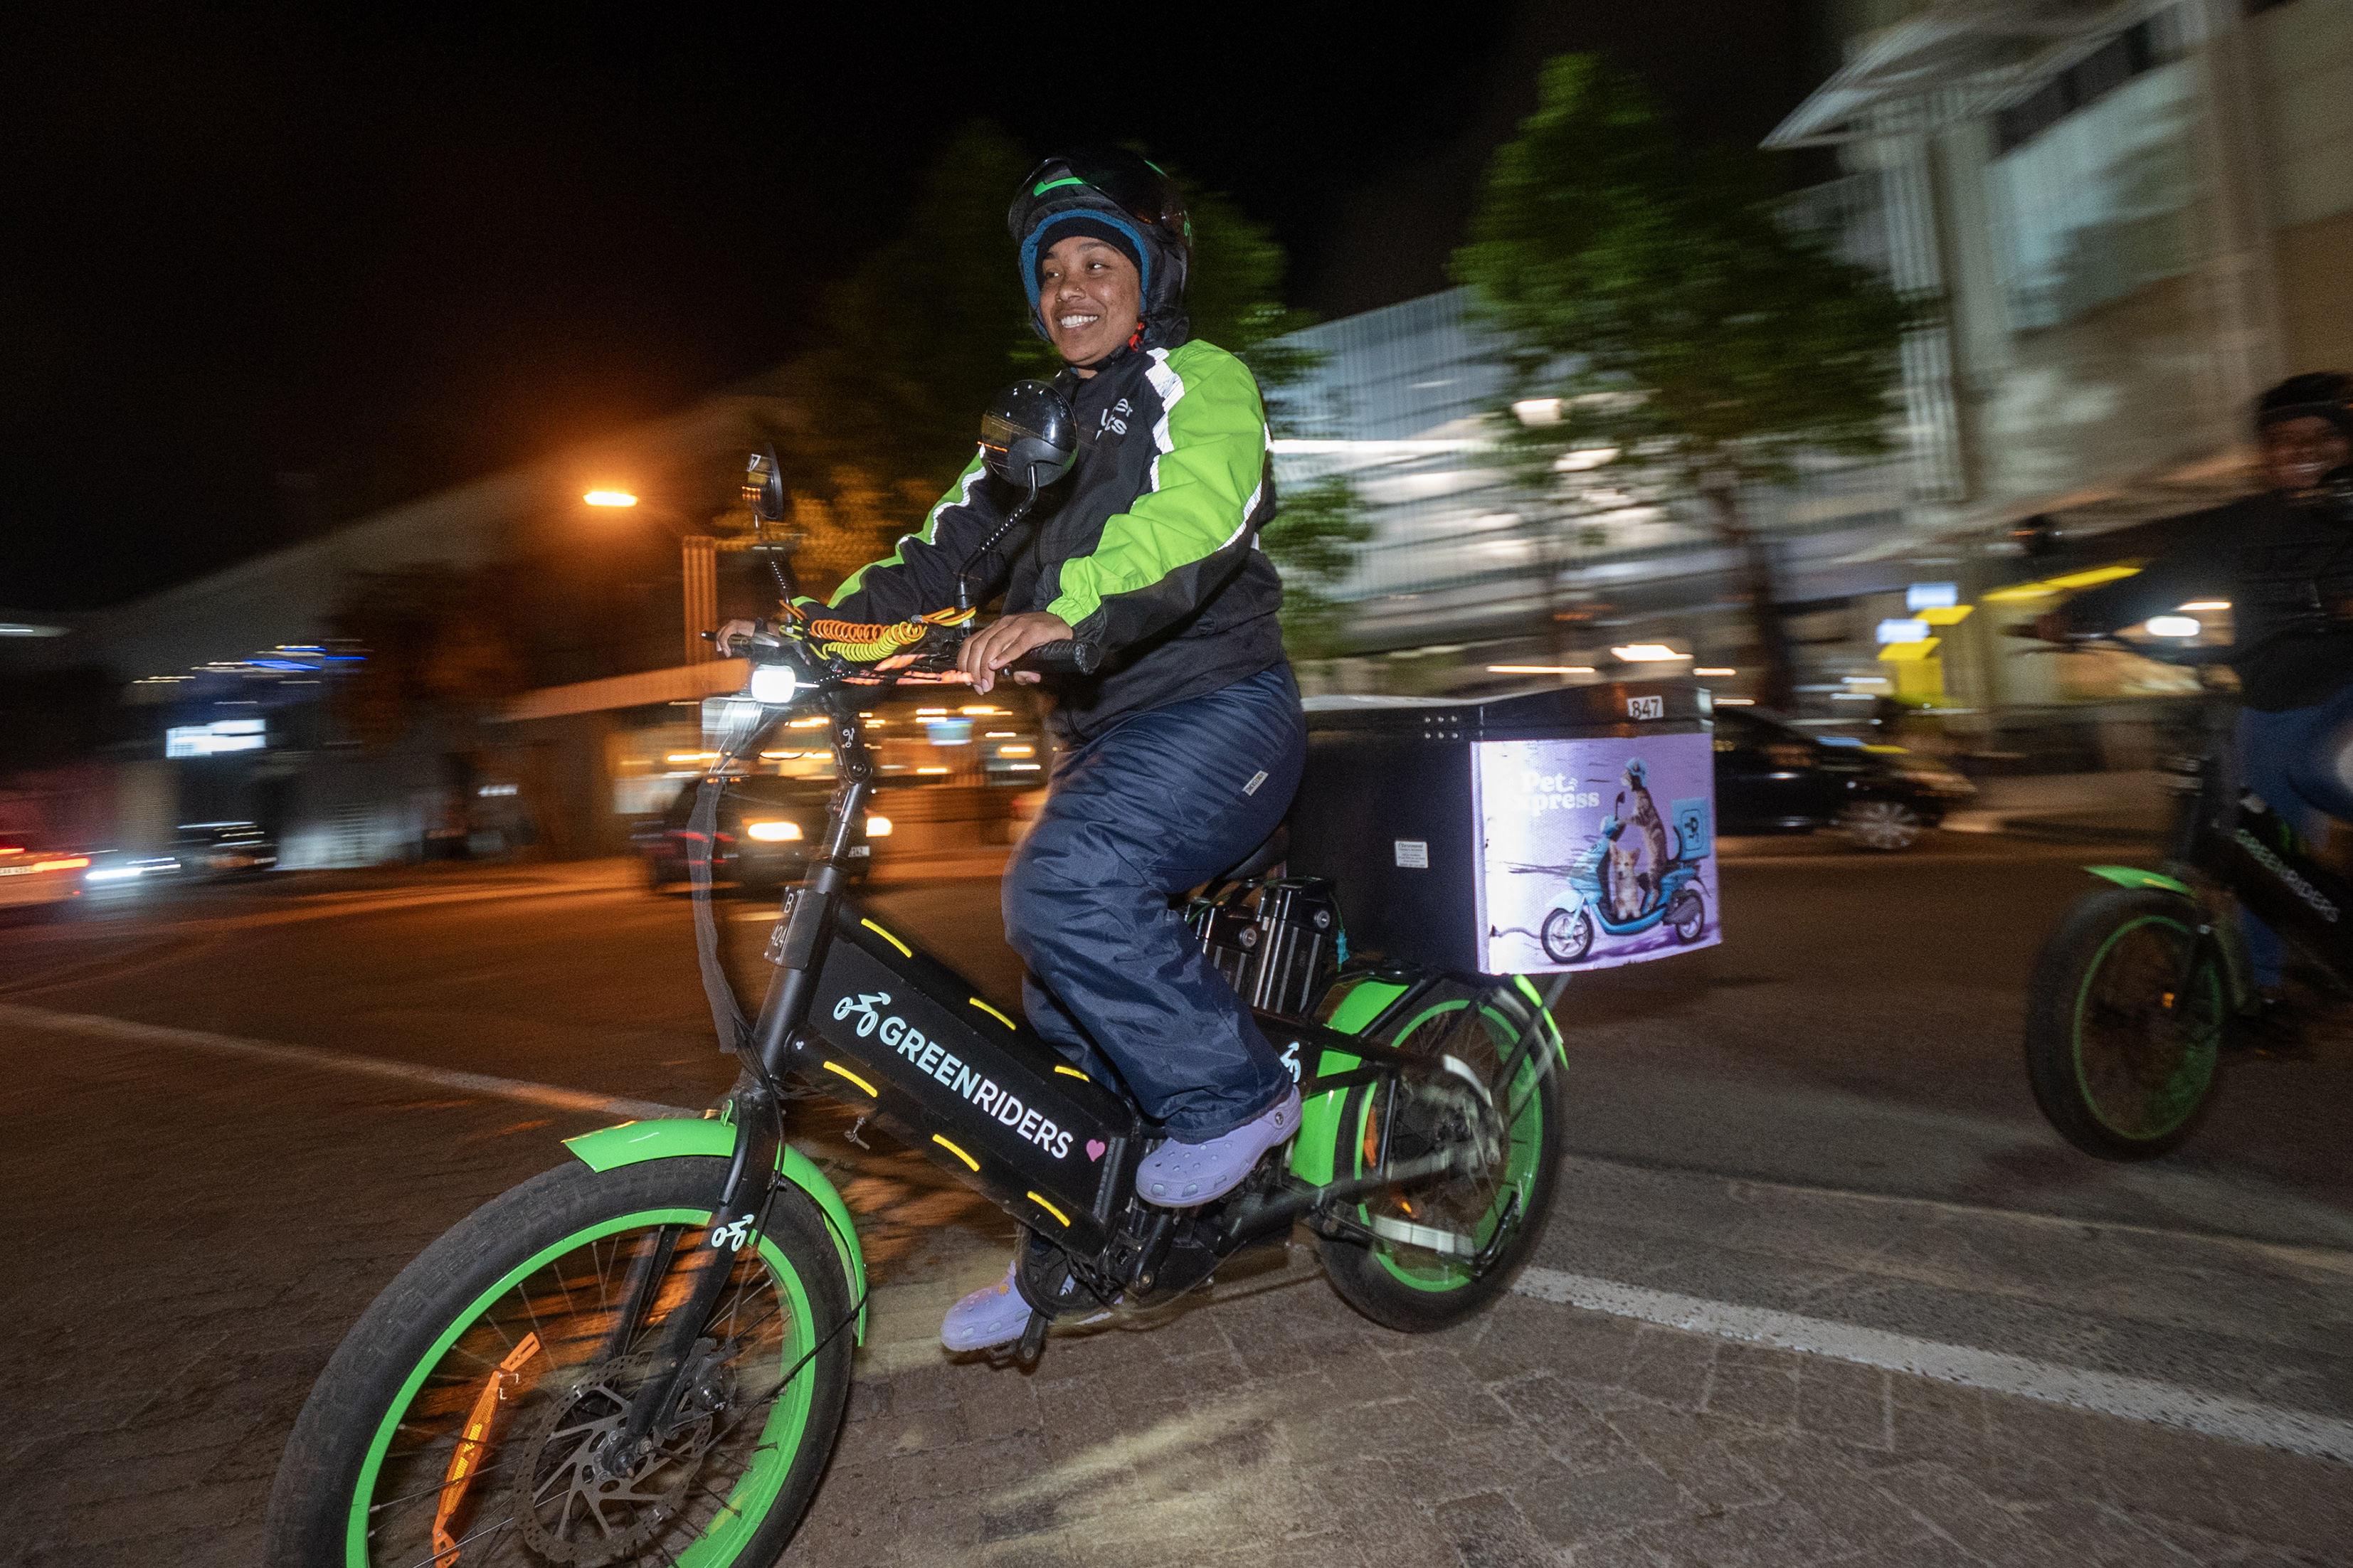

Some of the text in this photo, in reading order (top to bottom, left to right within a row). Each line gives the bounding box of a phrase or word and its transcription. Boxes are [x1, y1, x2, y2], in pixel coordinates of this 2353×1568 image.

[1632, 699, 1659, 719] 847
[1513, 792, 1600, 817] press
[783, 892, 794, 913] B
[879, 1016, 1074, 1159] GREENRIDERS
